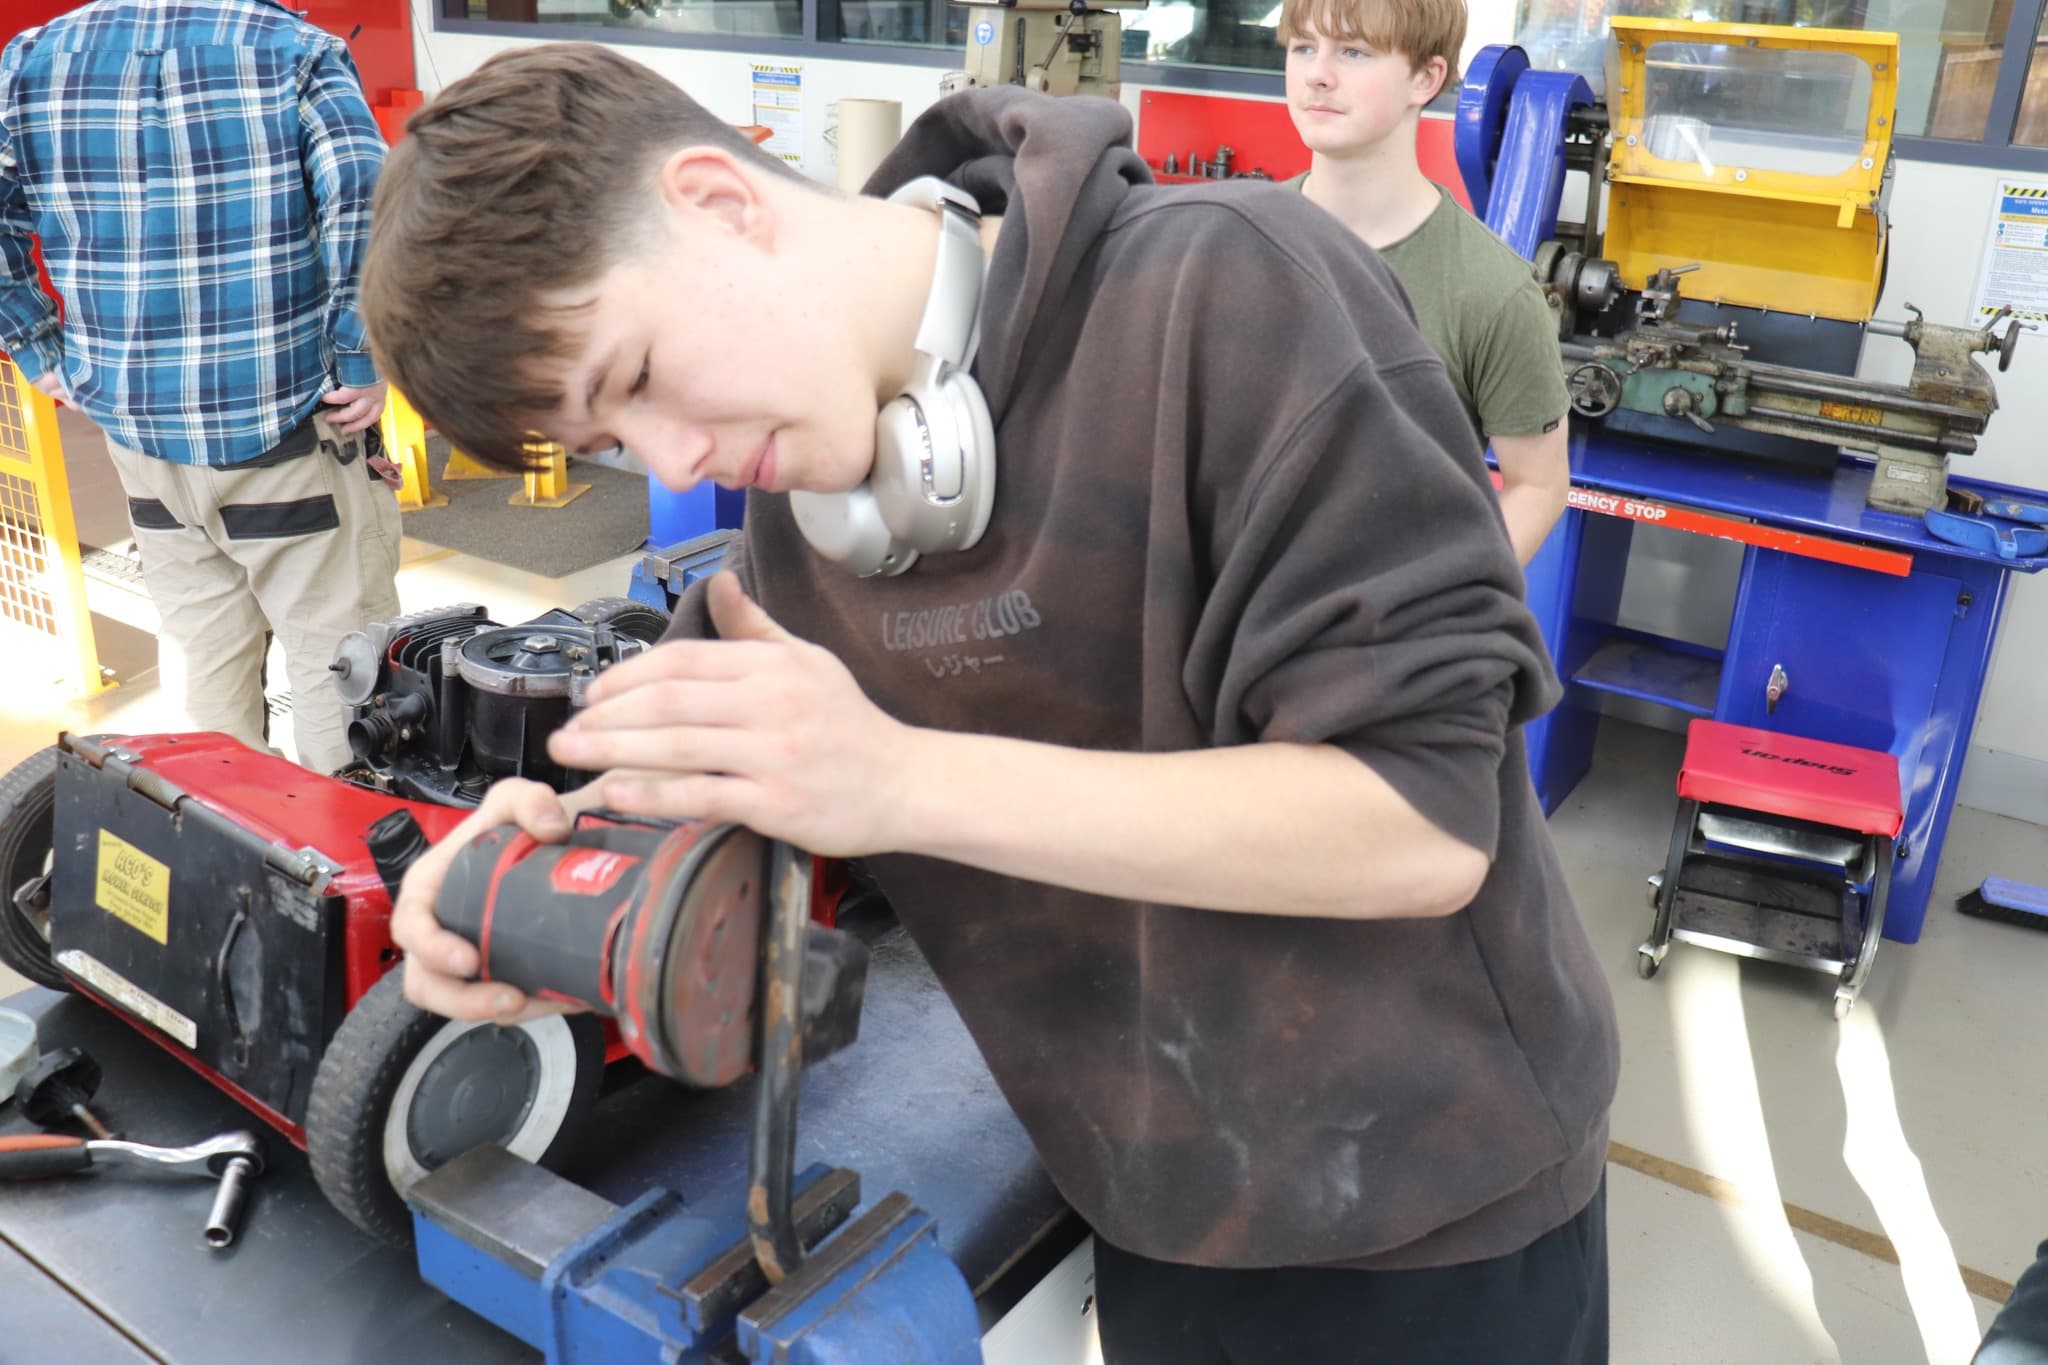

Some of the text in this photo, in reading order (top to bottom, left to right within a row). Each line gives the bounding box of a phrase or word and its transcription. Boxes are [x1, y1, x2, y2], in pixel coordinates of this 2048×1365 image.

[1567, 490, 1667, 520] GENCY STOP
[882, 589, 1042, 650] LEISURE CLUB
